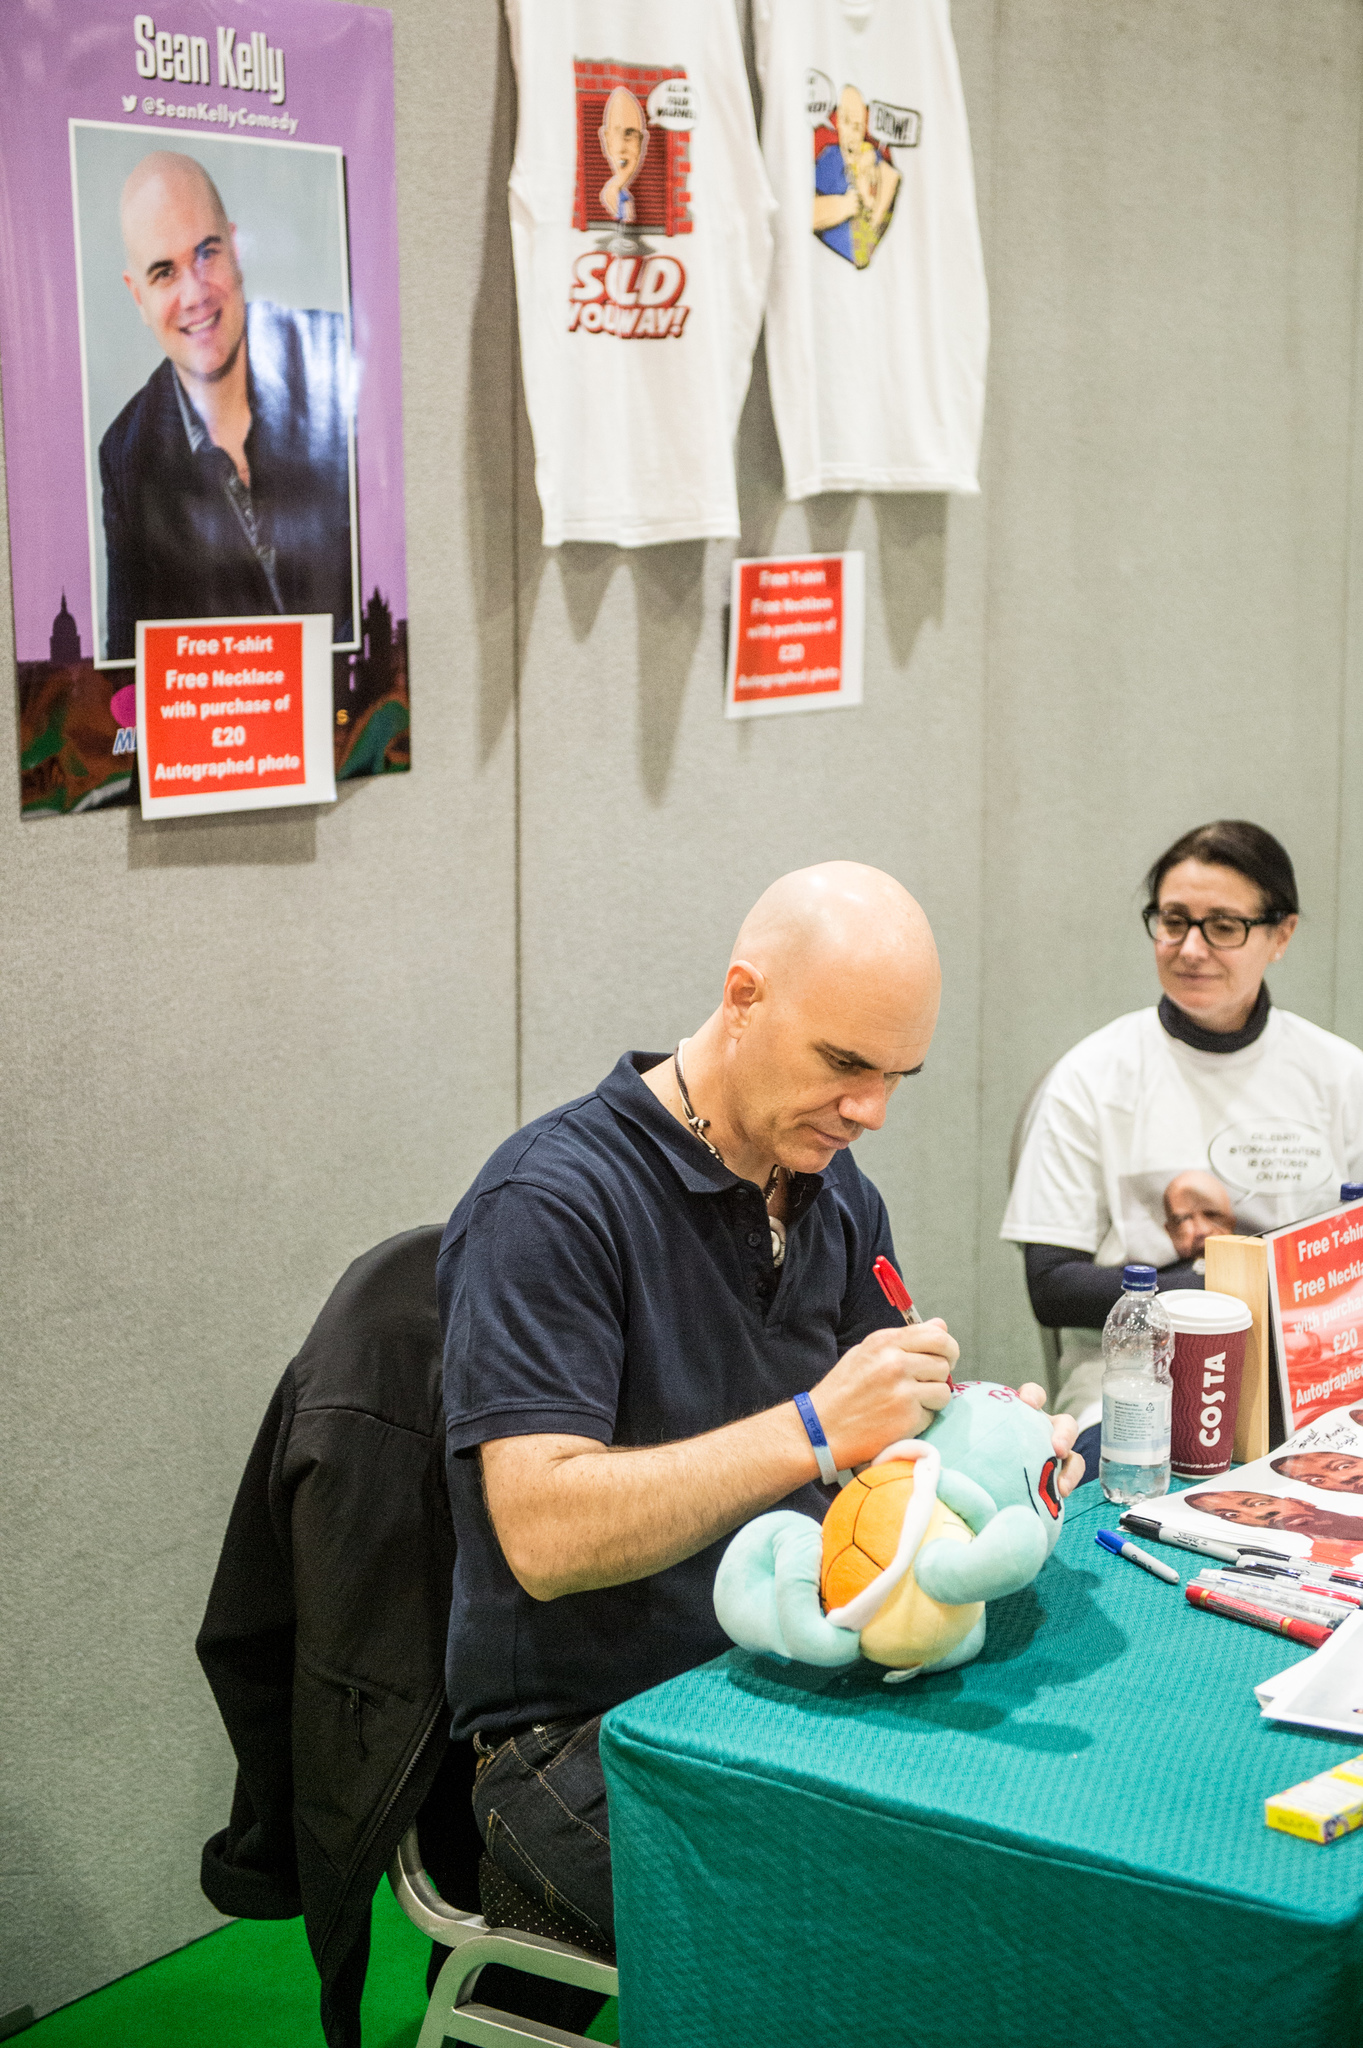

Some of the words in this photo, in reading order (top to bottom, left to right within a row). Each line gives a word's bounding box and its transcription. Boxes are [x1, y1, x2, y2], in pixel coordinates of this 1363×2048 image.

[133, 14, 210, 85] Sean
[216, 26, 286, 105] Kelly
[141, 97, 299, 135] @SeanKellyComedy
[177, 635, 220, 656] Free
[222, 636, 273, 655] T-shirt
[165, 668, 208, 690] Free
[212, 668, 285, 687] Necklace
[160, 700, 197, 719] with
[200, 696, 271, 720] purchase
[274, 693, 291, 712] of
[211, 725, 246, 747] £20
[154, 755, 255, 781] Autographed
[257, 753, 300, 775] photo
[1298, 1239, 1330, 1263] Free
[1293, 1279, 1326, 1303] Free
[1293, 1310, 1320, 1336] with
[1333, 1327, 1359, 1356] £20
[1199, 1351, 1226, 1447] COSTA
